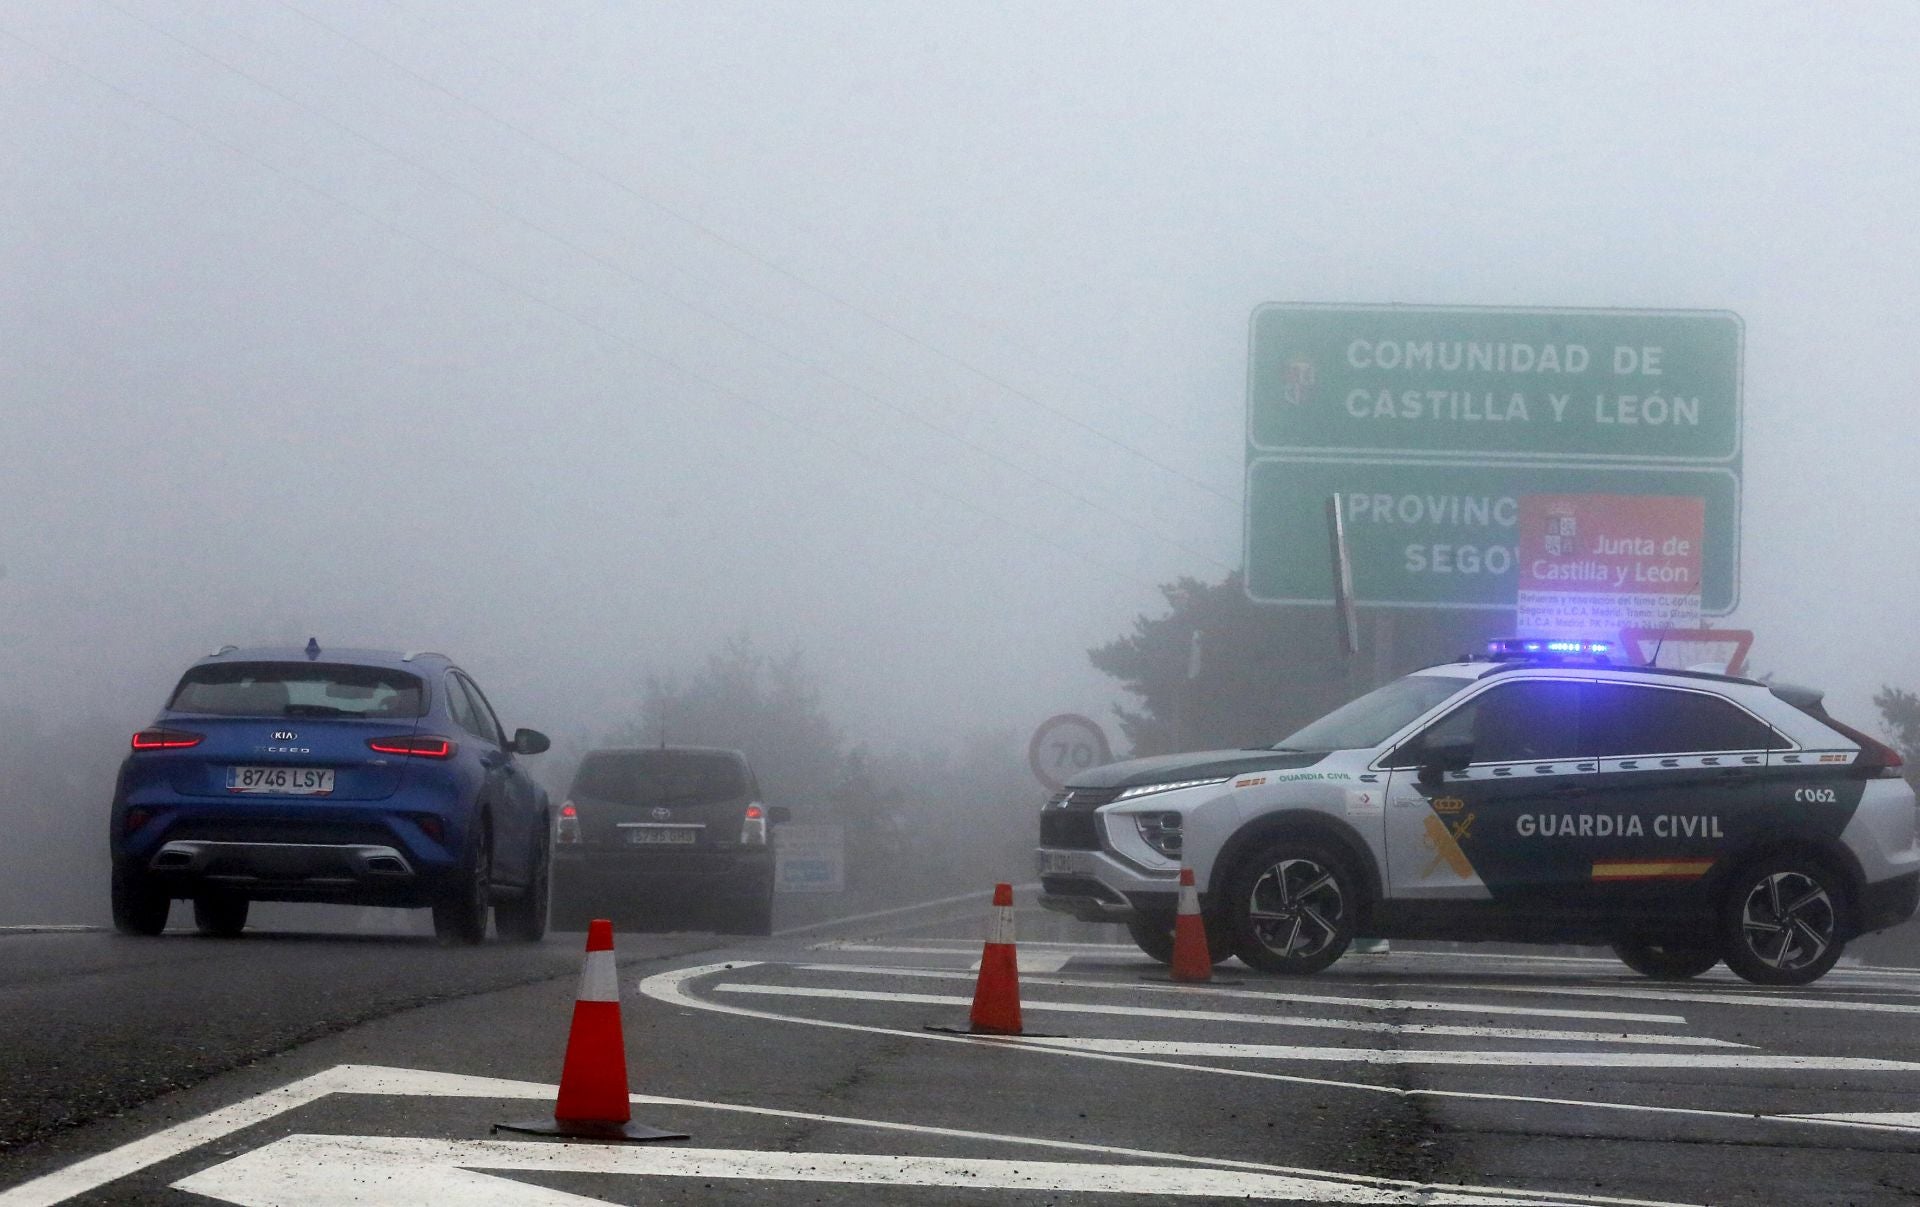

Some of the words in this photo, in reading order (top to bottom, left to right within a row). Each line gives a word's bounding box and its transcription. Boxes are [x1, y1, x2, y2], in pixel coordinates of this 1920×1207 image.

[1346, 341, 1590, 374] COMUNIDAD
[1613, 346, 1663, 375] DE
[1345, 389, 1529, 422] CASTILLA
[1549, 394, 1572, 422] Y
[1595, 388, 1701, 426] LEÓN
[1404, 543, 1520, 574] SEGO
[1593, 535, 1654, 556] Junta
[1662, 536, 1690, 556] de
[1531, 559, 1609, 580] Castilla
[1614, 566, 1628, 586] y
[1635, 561, 1689, 582] León
[273, 731, 295, 740] KIA
[1051, 742, 1093, 769] 70
[242, 769, 286, 788] 8746
[292, 770, 326, 788] LSY
[1278, 772, 1325, 783] GUARDIA
[1326, 771, 1352, 781] CIVIL
[1516, 813, 1644, 838] GUARDIA
[1653, 814, 1724, 839] CIVIL
